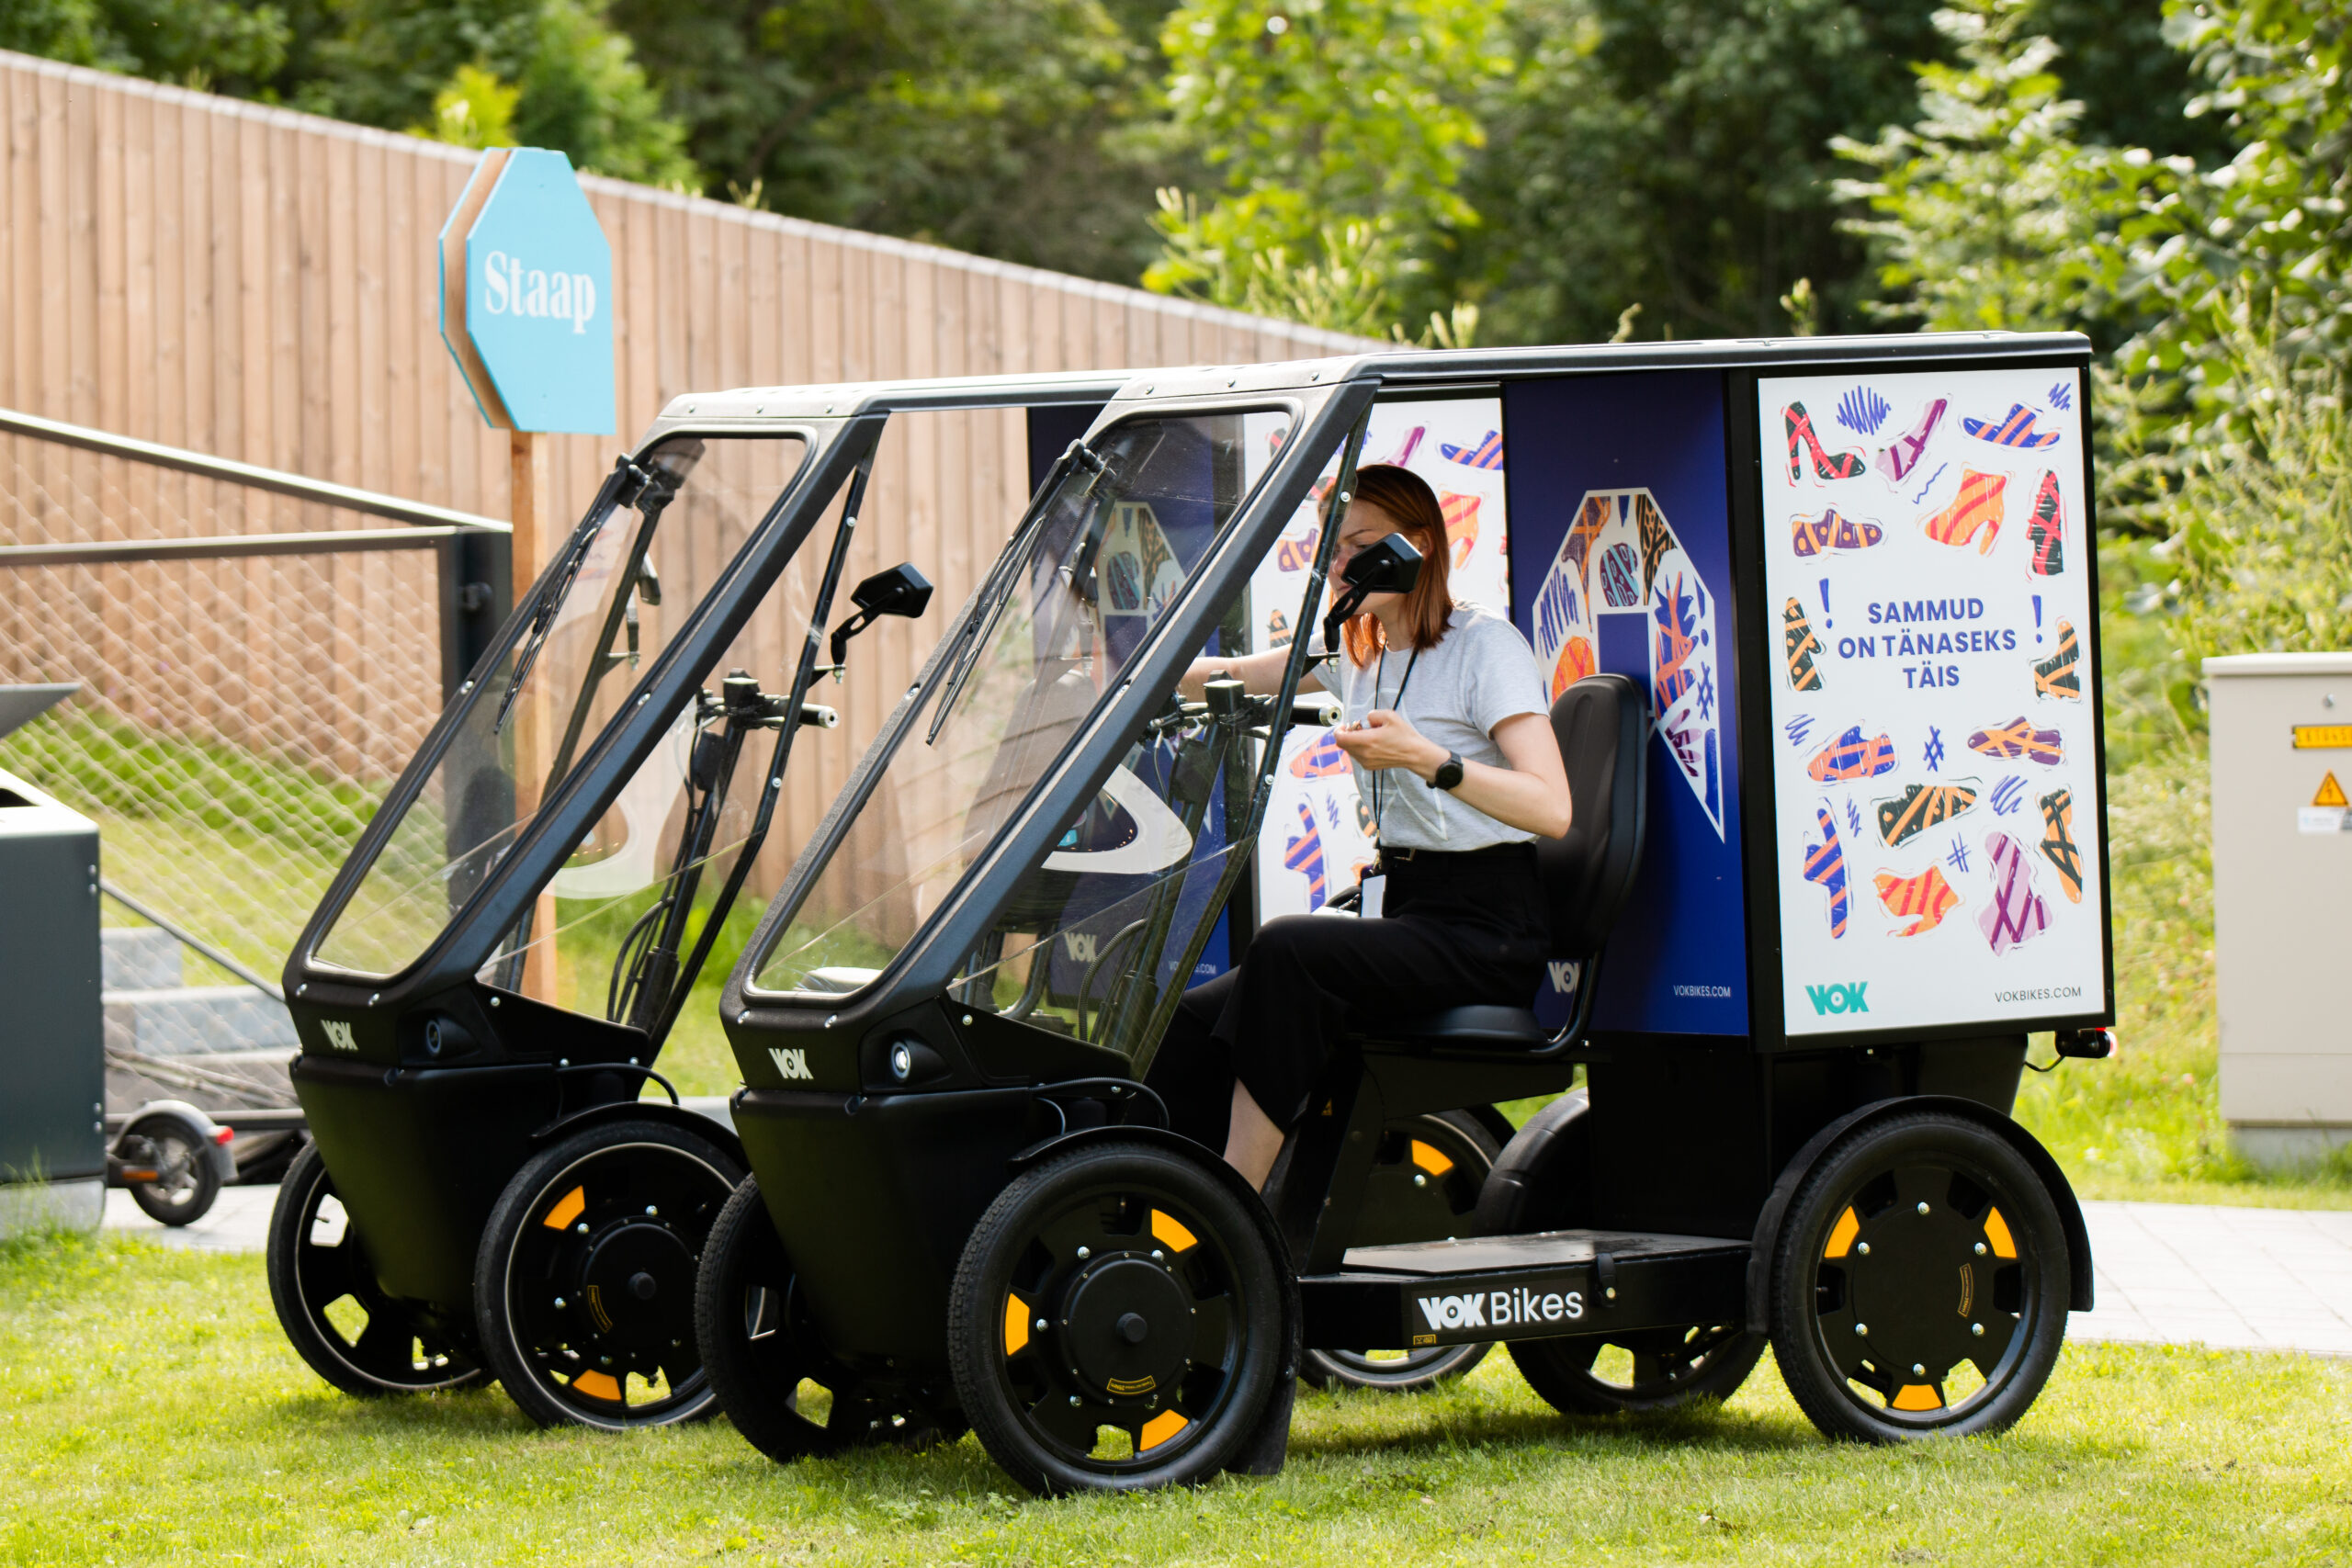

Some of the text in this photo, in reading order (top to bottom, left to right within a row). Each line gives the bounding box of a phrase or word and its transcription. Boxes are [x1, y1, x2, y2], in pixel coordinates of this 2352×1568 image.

[485, 250, 595, 334] Staap
[1867, 597, 1984, 625] SAMMUD
[1838, 627, 2017, 660] ON TÄNASEKS
[1902, 660, 1960, 689] TÄIS
[1673, 985, 1731, 998] VOKBIKES.COM
[1804, 981, 1870, 1016] VOK
[1994, 986, 2082, 1003] VOKBIKES.COM
[321, 1019, 358, 1051] VOK
[768, 1047, 814, 1080] VOK
[1418, 1287, 1584, 1330] VOK Bikes
